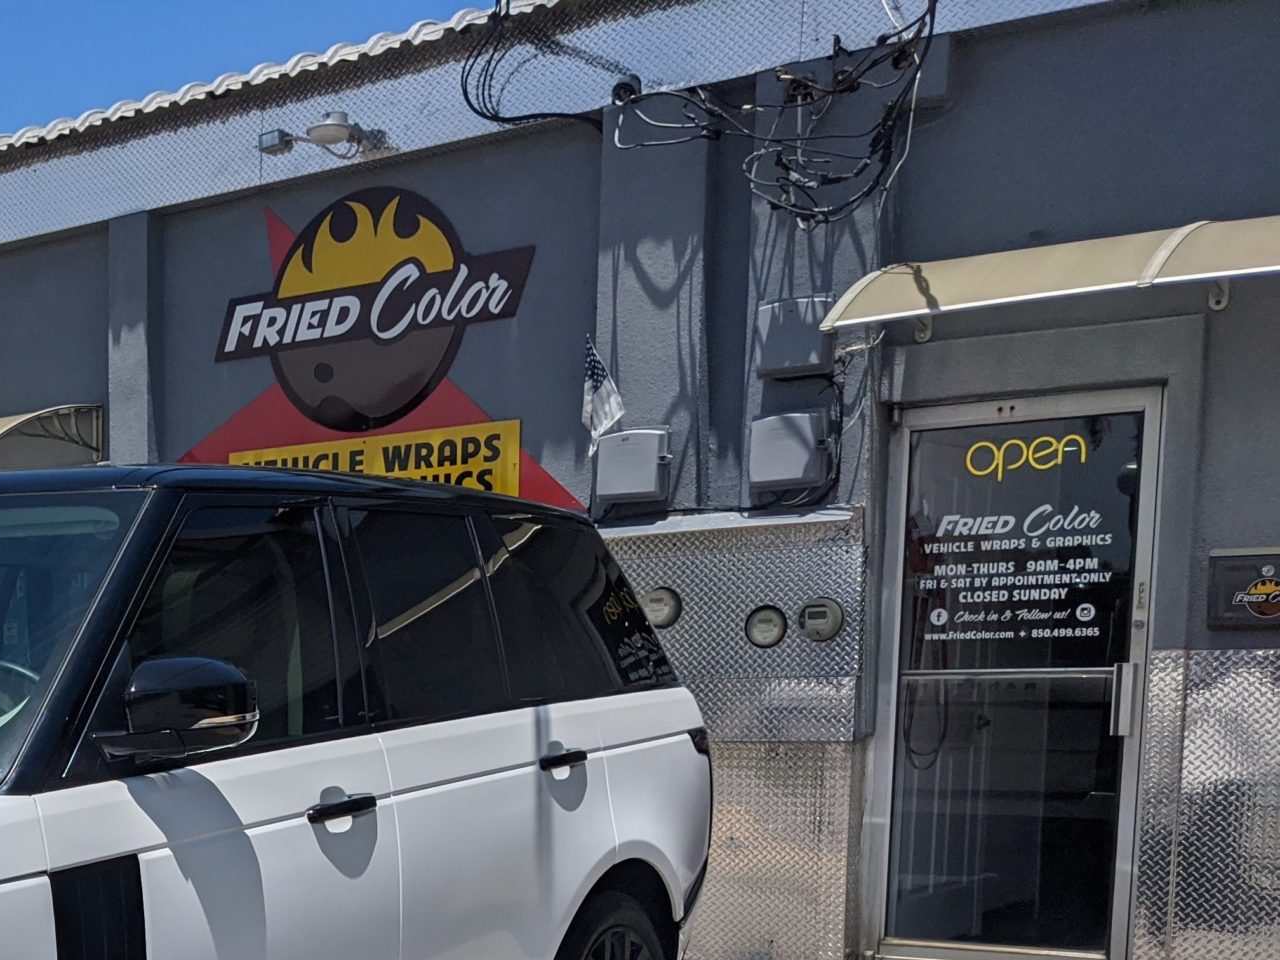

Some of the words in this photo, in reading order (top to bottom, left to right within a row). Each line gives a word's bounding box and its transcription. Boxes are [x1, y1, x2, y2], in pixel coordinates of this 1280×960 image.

[223, 294, 361, 354] FRIED
[369, 262, 515, 341] Color
[382, 433, 501, 473] WRAPS
[965, 433, 1088, 482] open
[935, 514, 1016, 537] FRIED
[1023, 503, 1103, 537] Color
[923, 541, 975, 555] VEHICLE
[980, 538, 1026, 551] WRAPS
[1031, 537, 1041, 548] &
[1046, 533, 1113, 548] GRAPHICS
[933, 561, 1015, 577] MON-THURS
[1026, 557, 1099, 573] 9AM-4PM
[919, 579, 937, 590] FRI
[939, 579, 948, 589] &
[950, 577, 971, 589] SAT
[974, 577, 987, 588] BY
[991, 573, 1079, 587] APPOINTMENT
[1080, 571, 1112, 583] ONLY
[958, 590, 1009, 603] CLOSED
[1012, 588, 1068, 602] SUNDAY
[1235, 594, 1267, 603] FRIED
[954, 610, 986, 623] Check
[986, 610, 998, 622] in
[1015, 608, 1052, 621] Follow
[1053, 608, 1071, 620] us!
[924, 630, 1015, 641] www.FriedColor.com
[1031, 627, 1100, 638] 850.499.6365
